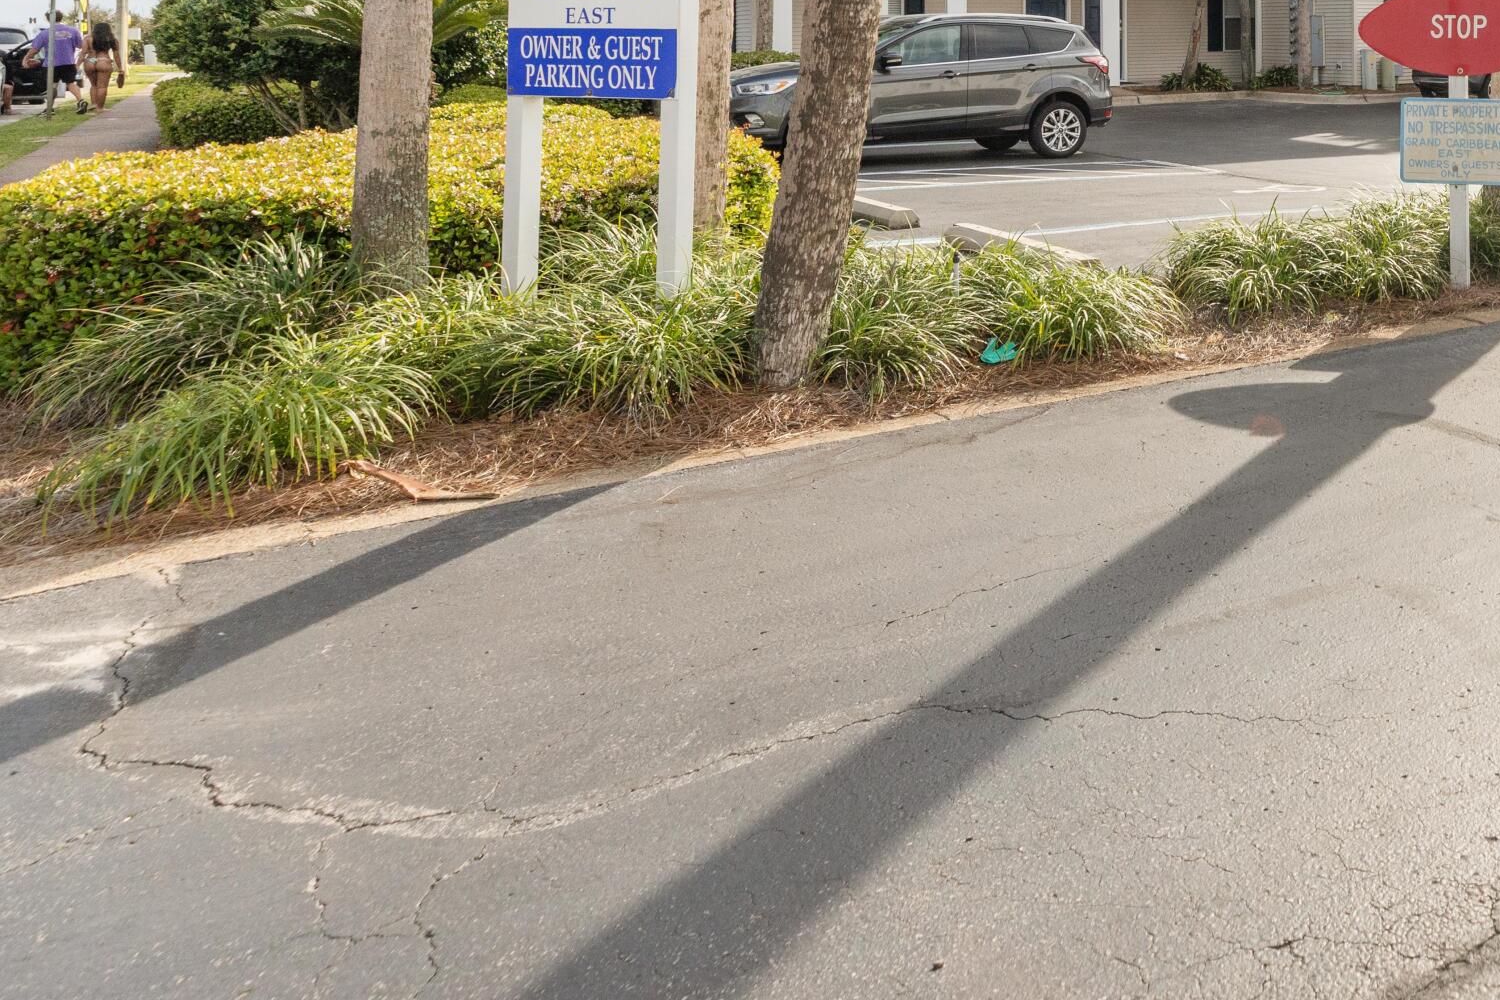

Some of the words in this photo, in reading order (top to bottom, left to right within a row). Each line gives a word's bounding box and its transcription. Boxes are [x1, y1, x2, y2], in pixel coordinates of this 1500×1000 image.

[565, 7, 616, 24] EAST
[1430, 14, 1488, 39] STOP
[520, 35, 583, 60] OWNER
[587, 36, 601, 60] &
[604, 36, 663, 61] GUEST
[524, 64, 604, 89] PARKING
[607, 65, 657, 90] ONLY
[1406, 104, 1449, 117] PRIVATE
[1407, 121, 1424, 134] NO
[1405, 137, 1441, 147] GRAND
[1438, 149, 1472, 158] EAST
[1408, 159, 1450, 169] OWNERS
[1440, 170, 1471, 179] ONLY
